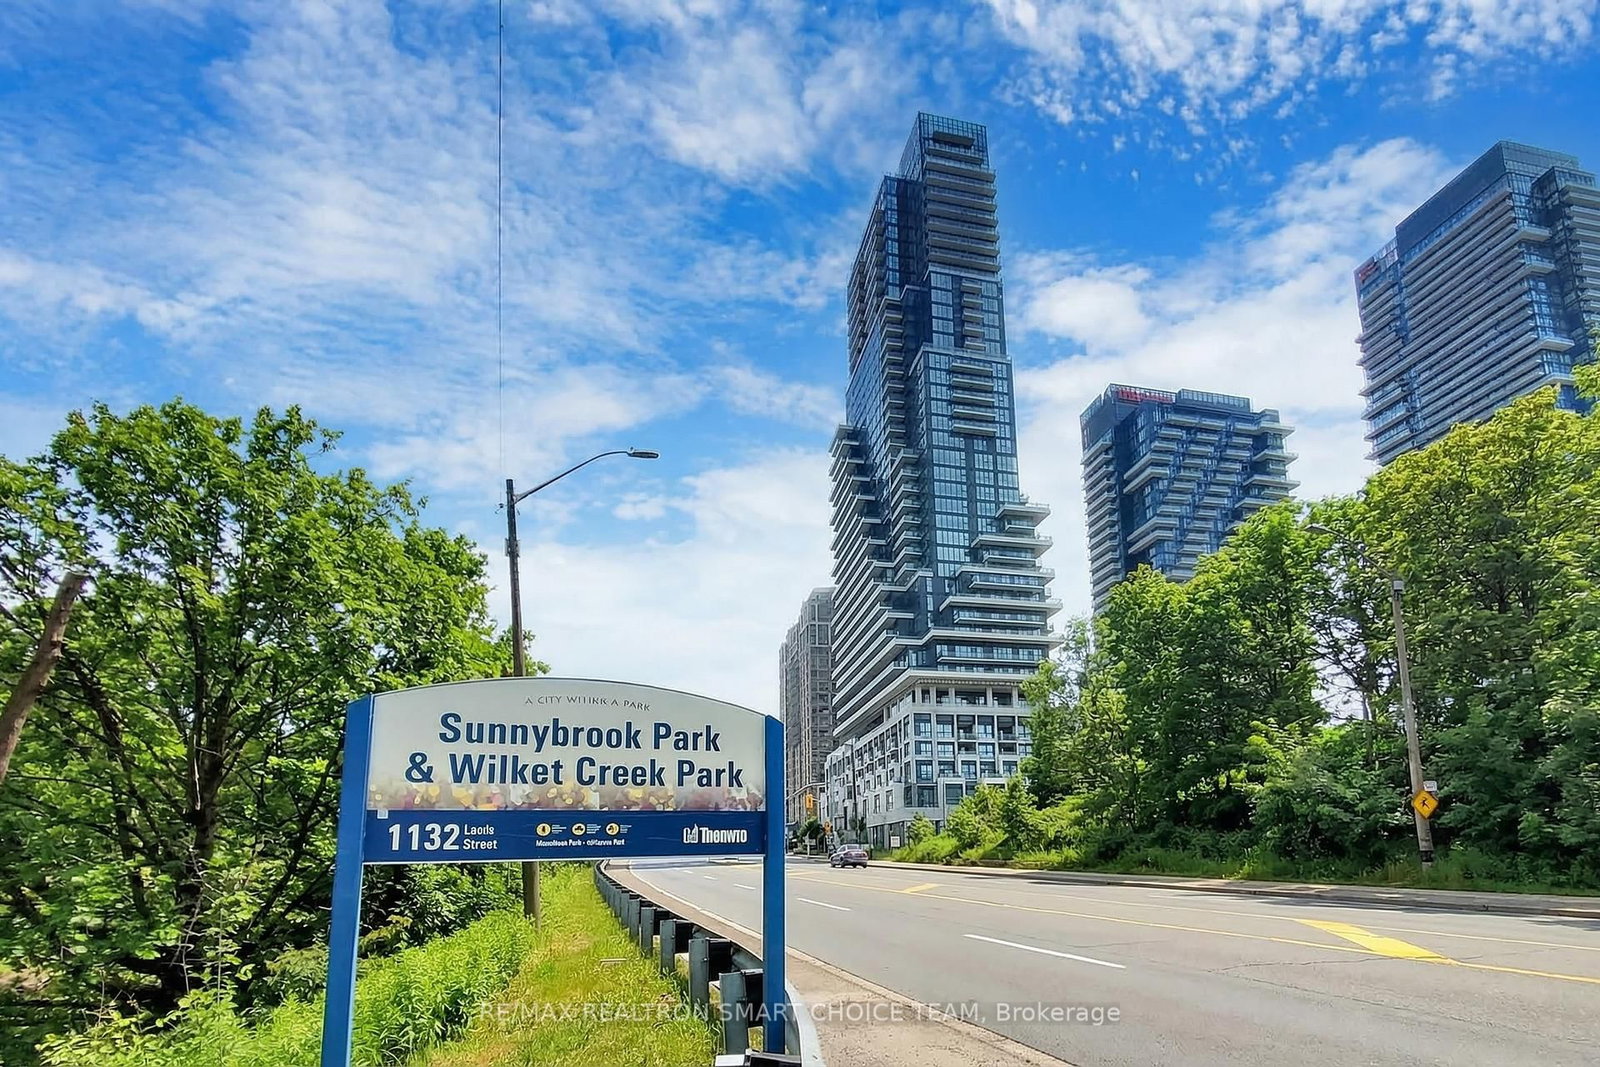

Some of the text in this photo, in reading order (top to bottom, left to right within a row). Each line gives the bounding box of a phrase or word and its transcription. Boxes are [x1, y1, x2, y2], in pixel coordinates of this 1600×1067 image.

[537, 695, 562, 704] CITY
[611, 698, 619, 706] A
[623, 699, 651, 711] PARK
[439, 712, 721, 752] Sunnybrook Park
[405, 752, 744, 788] & Wilket Creek Park
[388, 823, 460, 851] 1132
[462, 838, 498, 850] Street
